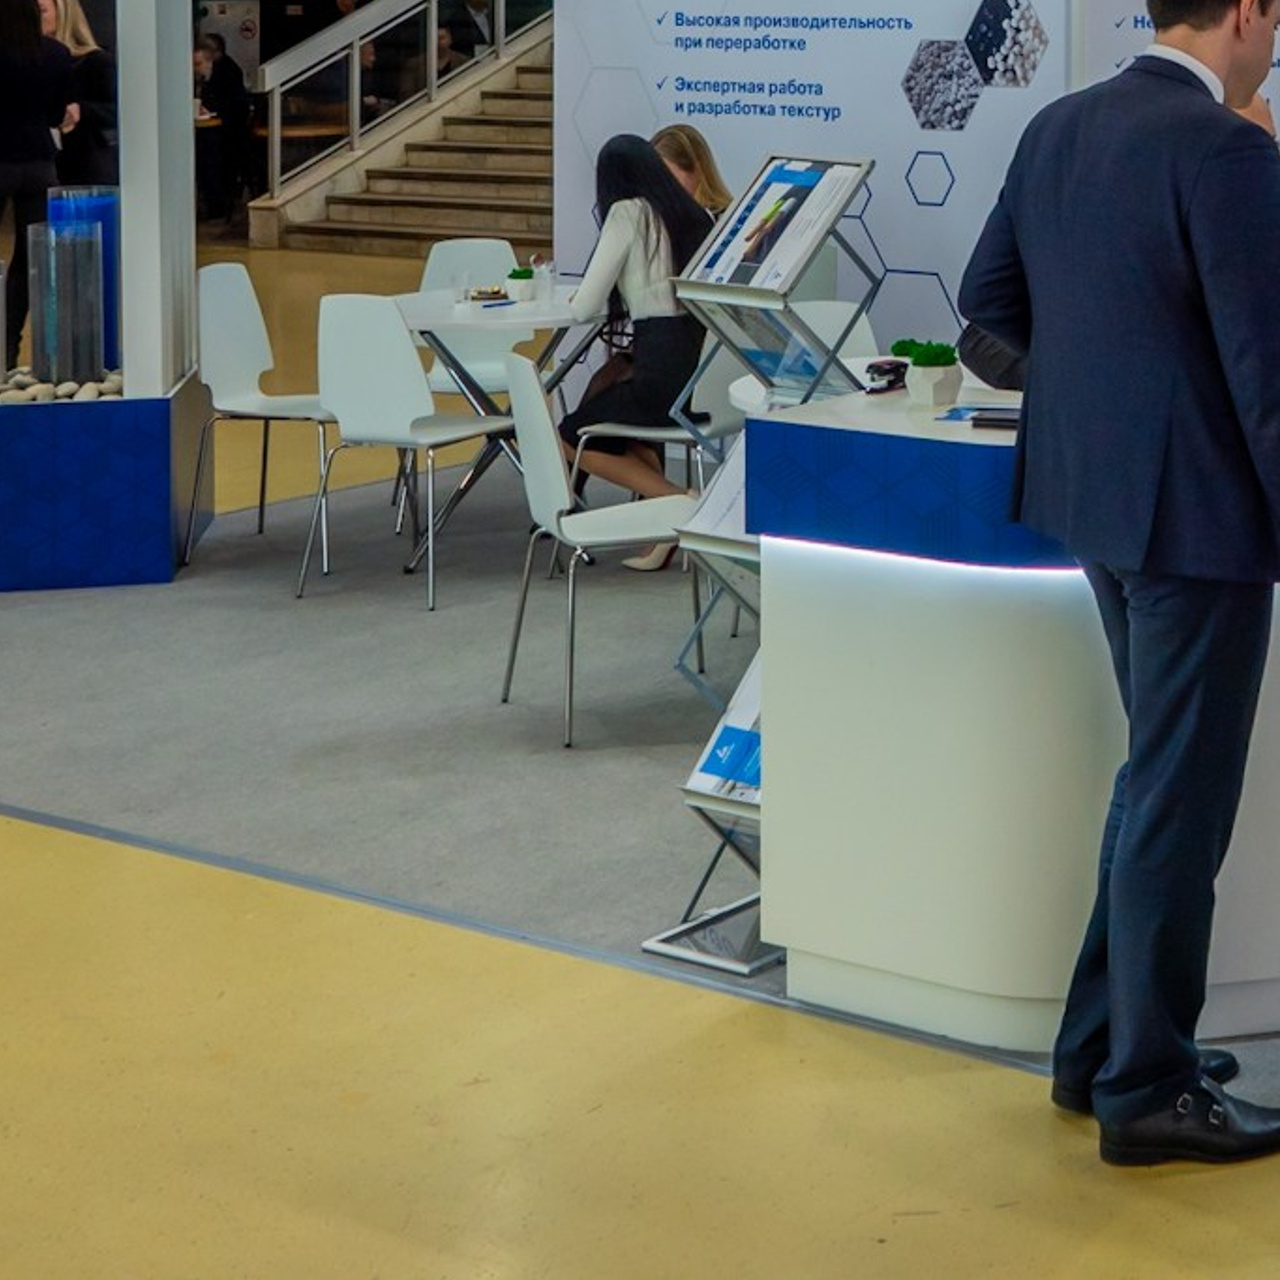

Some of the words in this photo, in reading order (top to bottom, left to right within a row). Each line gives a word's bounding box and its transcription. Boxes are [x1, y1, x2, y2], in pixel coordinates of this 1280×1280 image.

[675, 12, 740, 27] Высокая
[744, 16, 913, 30] производительность
[675, 37, 703, 51] при
[706, 34, 806, 52] переработке
[675, 76, 765, 95] Экспертная
[769, 79, 823, 97] работа
[675, 102, 684, 113] и
[687, 100, 776, 117] разработка
[780, 105, 841, 122] текстур
